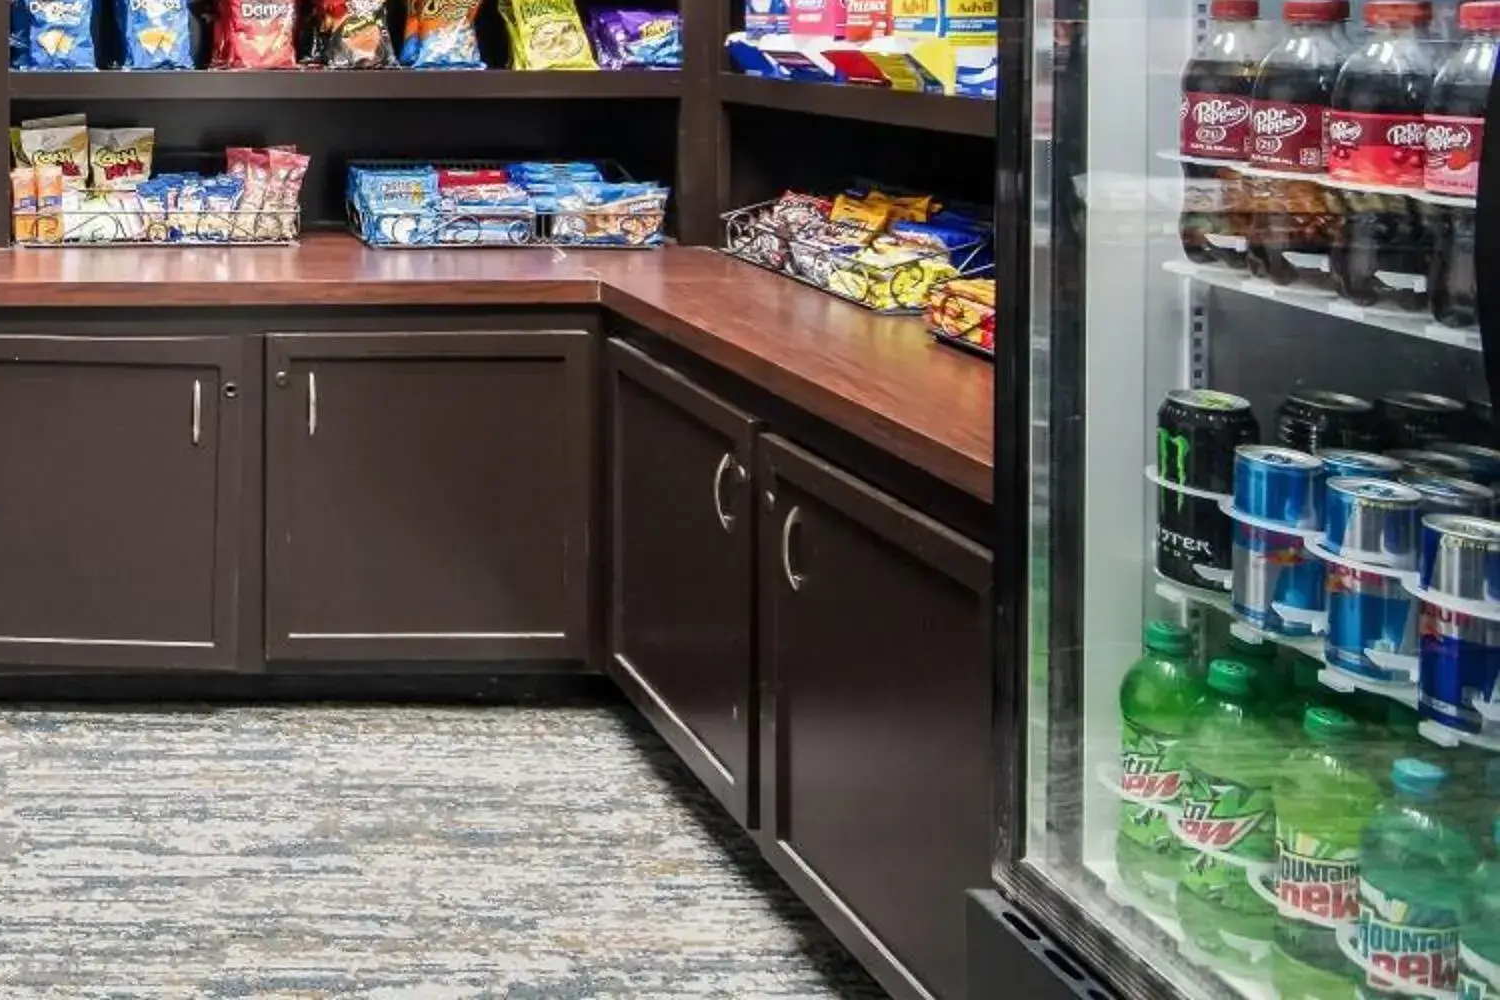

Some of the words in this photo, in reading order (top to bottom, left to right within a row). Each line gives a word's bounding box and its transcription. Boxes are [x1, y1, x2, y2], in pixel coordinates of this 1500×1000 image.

[957, 0, 994, 13] Advil
[1193, 101, 1245, 124] Pepper
[1254, 111, 1300, 134] Pepper
[34, 147, 74, 167] CORN
[95, 147, 140, 167] CORN
